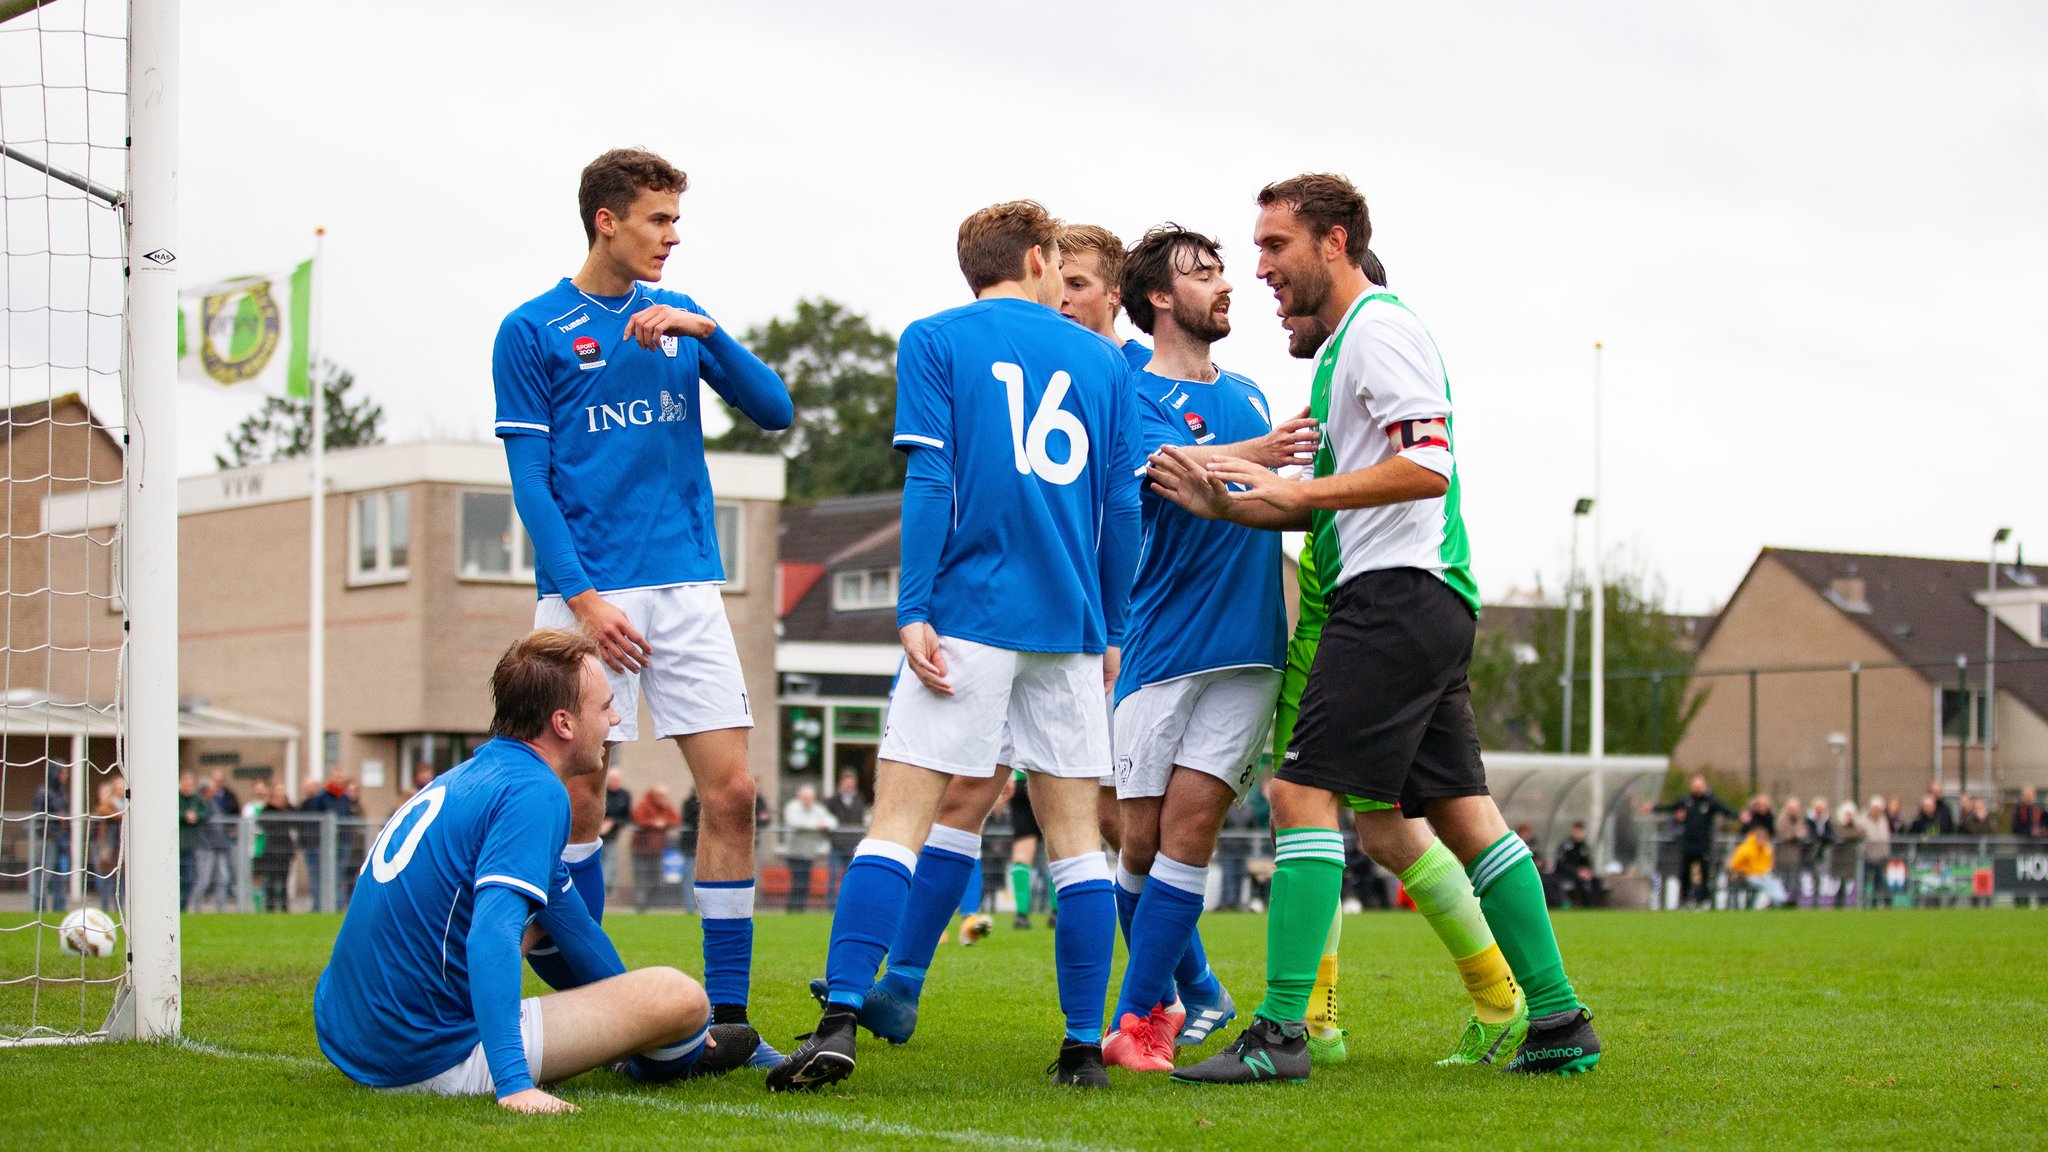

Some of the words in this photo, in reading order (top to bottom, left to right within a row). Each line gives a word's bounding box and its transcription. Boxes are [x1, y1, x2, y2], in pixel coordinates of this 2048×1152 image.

[154, 253, 171, 261] RAS
[559, 313, 590, 333] hummel
[576, 342, 595, 351] SPORT
[579, 348, 596, 356] 2000
[585, 399, 654, 433] ING
[991, 361, 1089, 486] 16
[2016, 852, 2048, 881] HO
[1525, 1046, 1584, 1062] balance
